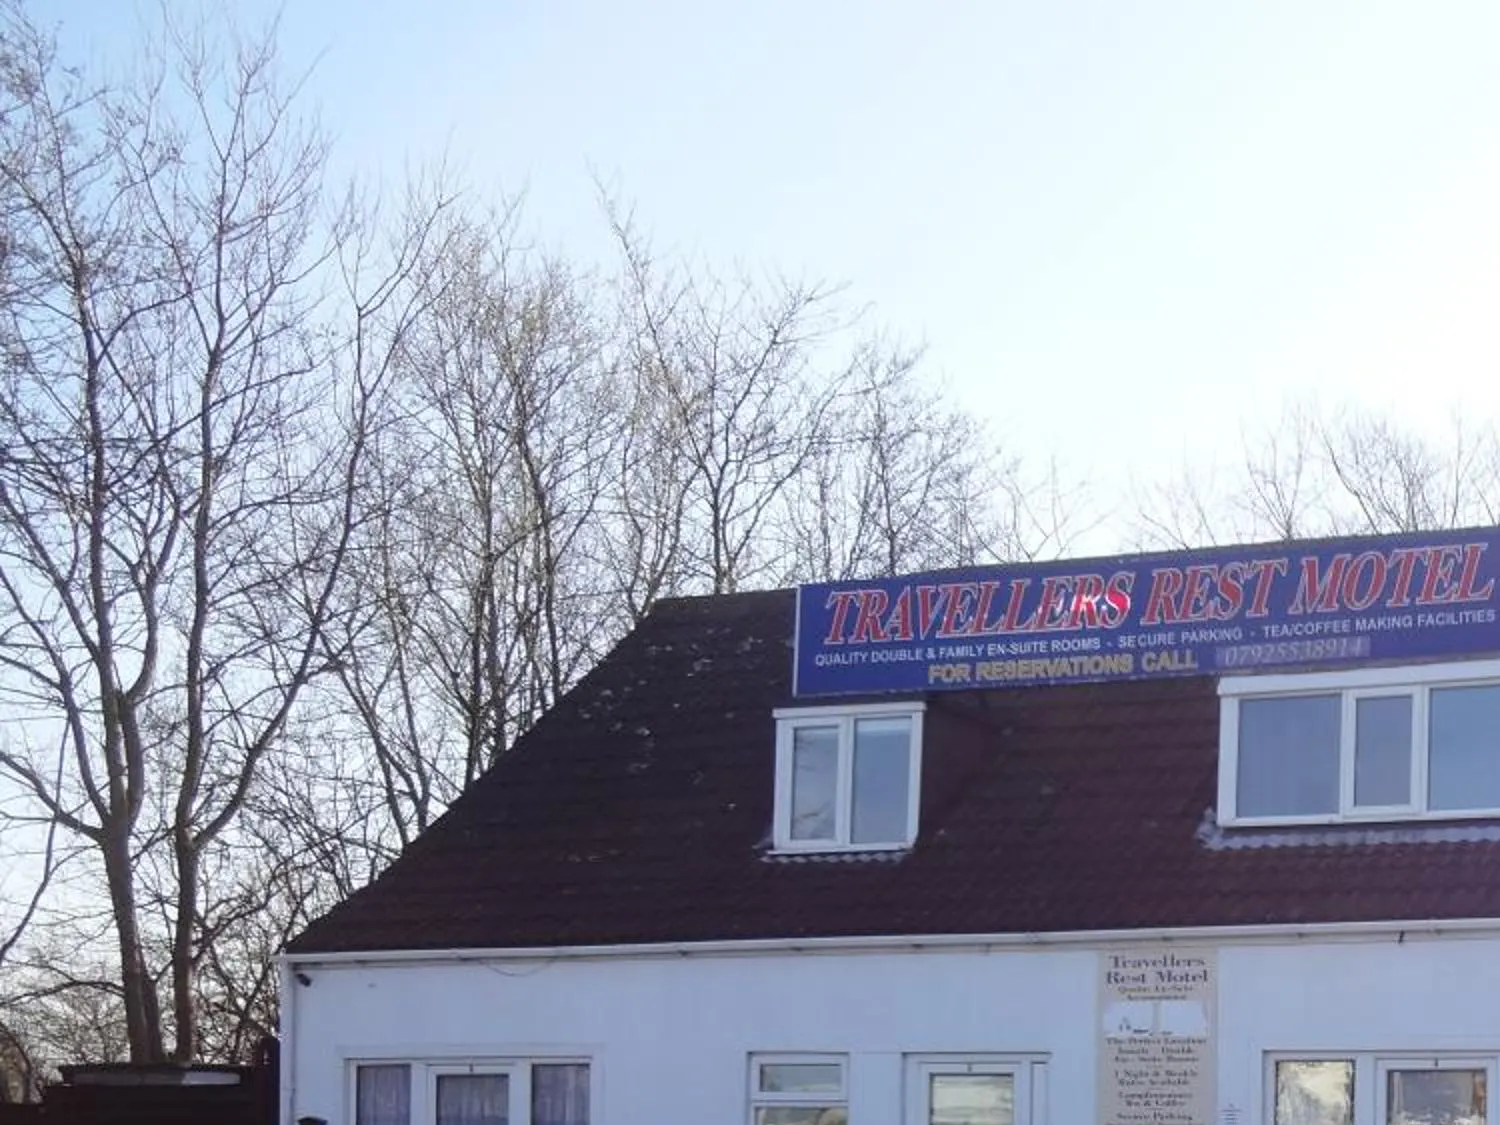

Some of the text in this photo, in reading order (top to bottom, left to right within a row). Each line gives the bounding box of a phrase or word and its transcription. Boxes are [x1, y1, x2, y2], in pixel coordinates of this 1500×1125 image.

[824, 542, 1496, 644] TRAVELLERS REST MOTEL
[815, 609, 1496, 667] QUALITY DOUBLE & FAMILY EN-SUITE ROOMS SECURE PARKING TEA/COFFEE MAKING FACILITIES
[927, 663, 972, 685] FOR
[975, 653, 1133, 681] RESERVATIONS
[1141, 648, 1199, 673] CALL
[1106, 968, 1209, 984] Rest Motel
[1108, 953, 1206, 969] Travellers
